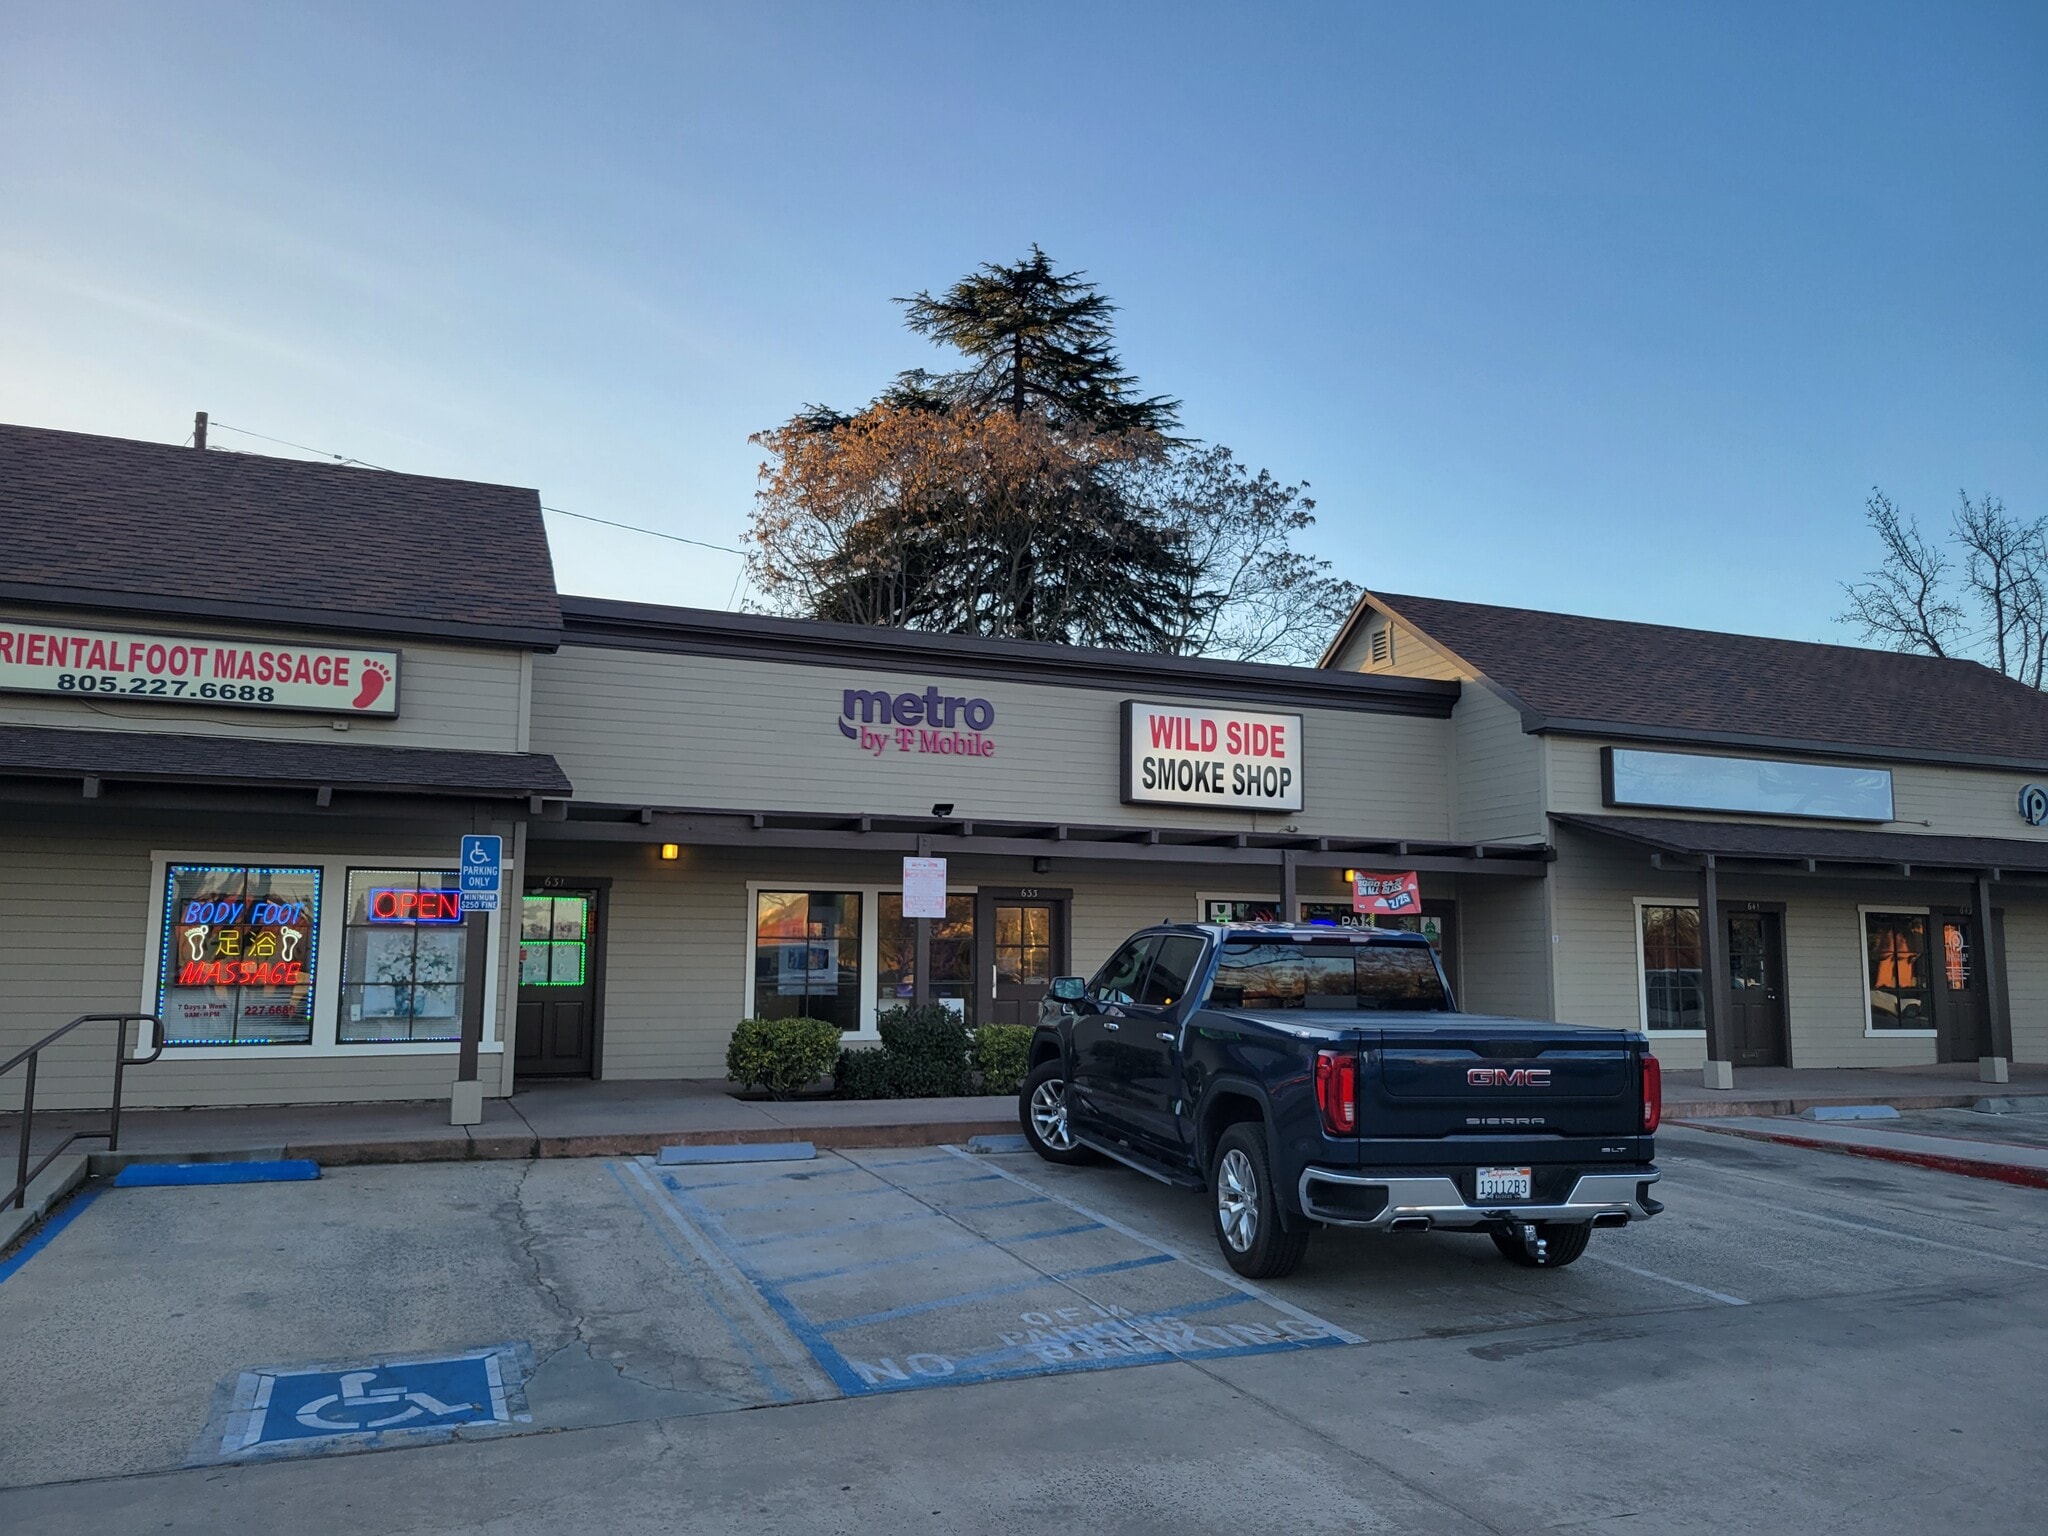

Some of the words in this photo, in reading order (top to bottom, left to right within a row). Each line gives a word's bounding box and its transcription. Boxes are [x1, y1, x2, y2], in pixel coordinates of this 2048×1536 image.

[128, 642, 208, 677] FOOT
[213, 648, 350, 687] MASSAGE
[57, 673, 274, 702] 805.227.6688
[844, 686, 995, 731] metro
[860, 725, 889, 757] by
[1149, 714, 1218, 753] WILD
[1226, 721, 1285, 759] SIDE
[1142, 756, 1225, 794] SMOKE
[1232, 763, 1292, 798] SHOP
[463, 865, 498, 876] PARKING
[468, 876, 490, 887] ONLY
[544, 876, 565, 887] 631
[1021, 889, 1038, 898] 633
[1367, 886, 1379, 895] ALL
[1388, 893, 1411, 909] 2/25
[185, 901, 245, 924] BODY
[251, 901, 305, 925] FOOT
[375, 891, 458, 918] OPEN
[461, 901, 479, 909] $250
[481, 901, 497, 909] FINE
[215, 930, 277, 957] 足浴
[179, 961, 302, 984] MASSAGE
[183, 1003, 201, 1012] Days
[1467, 1069, 1551, 1087] GMC
[1466, 1117, 1545, 1125] SIERRA
[849, 1352, 956, 1385] NO
